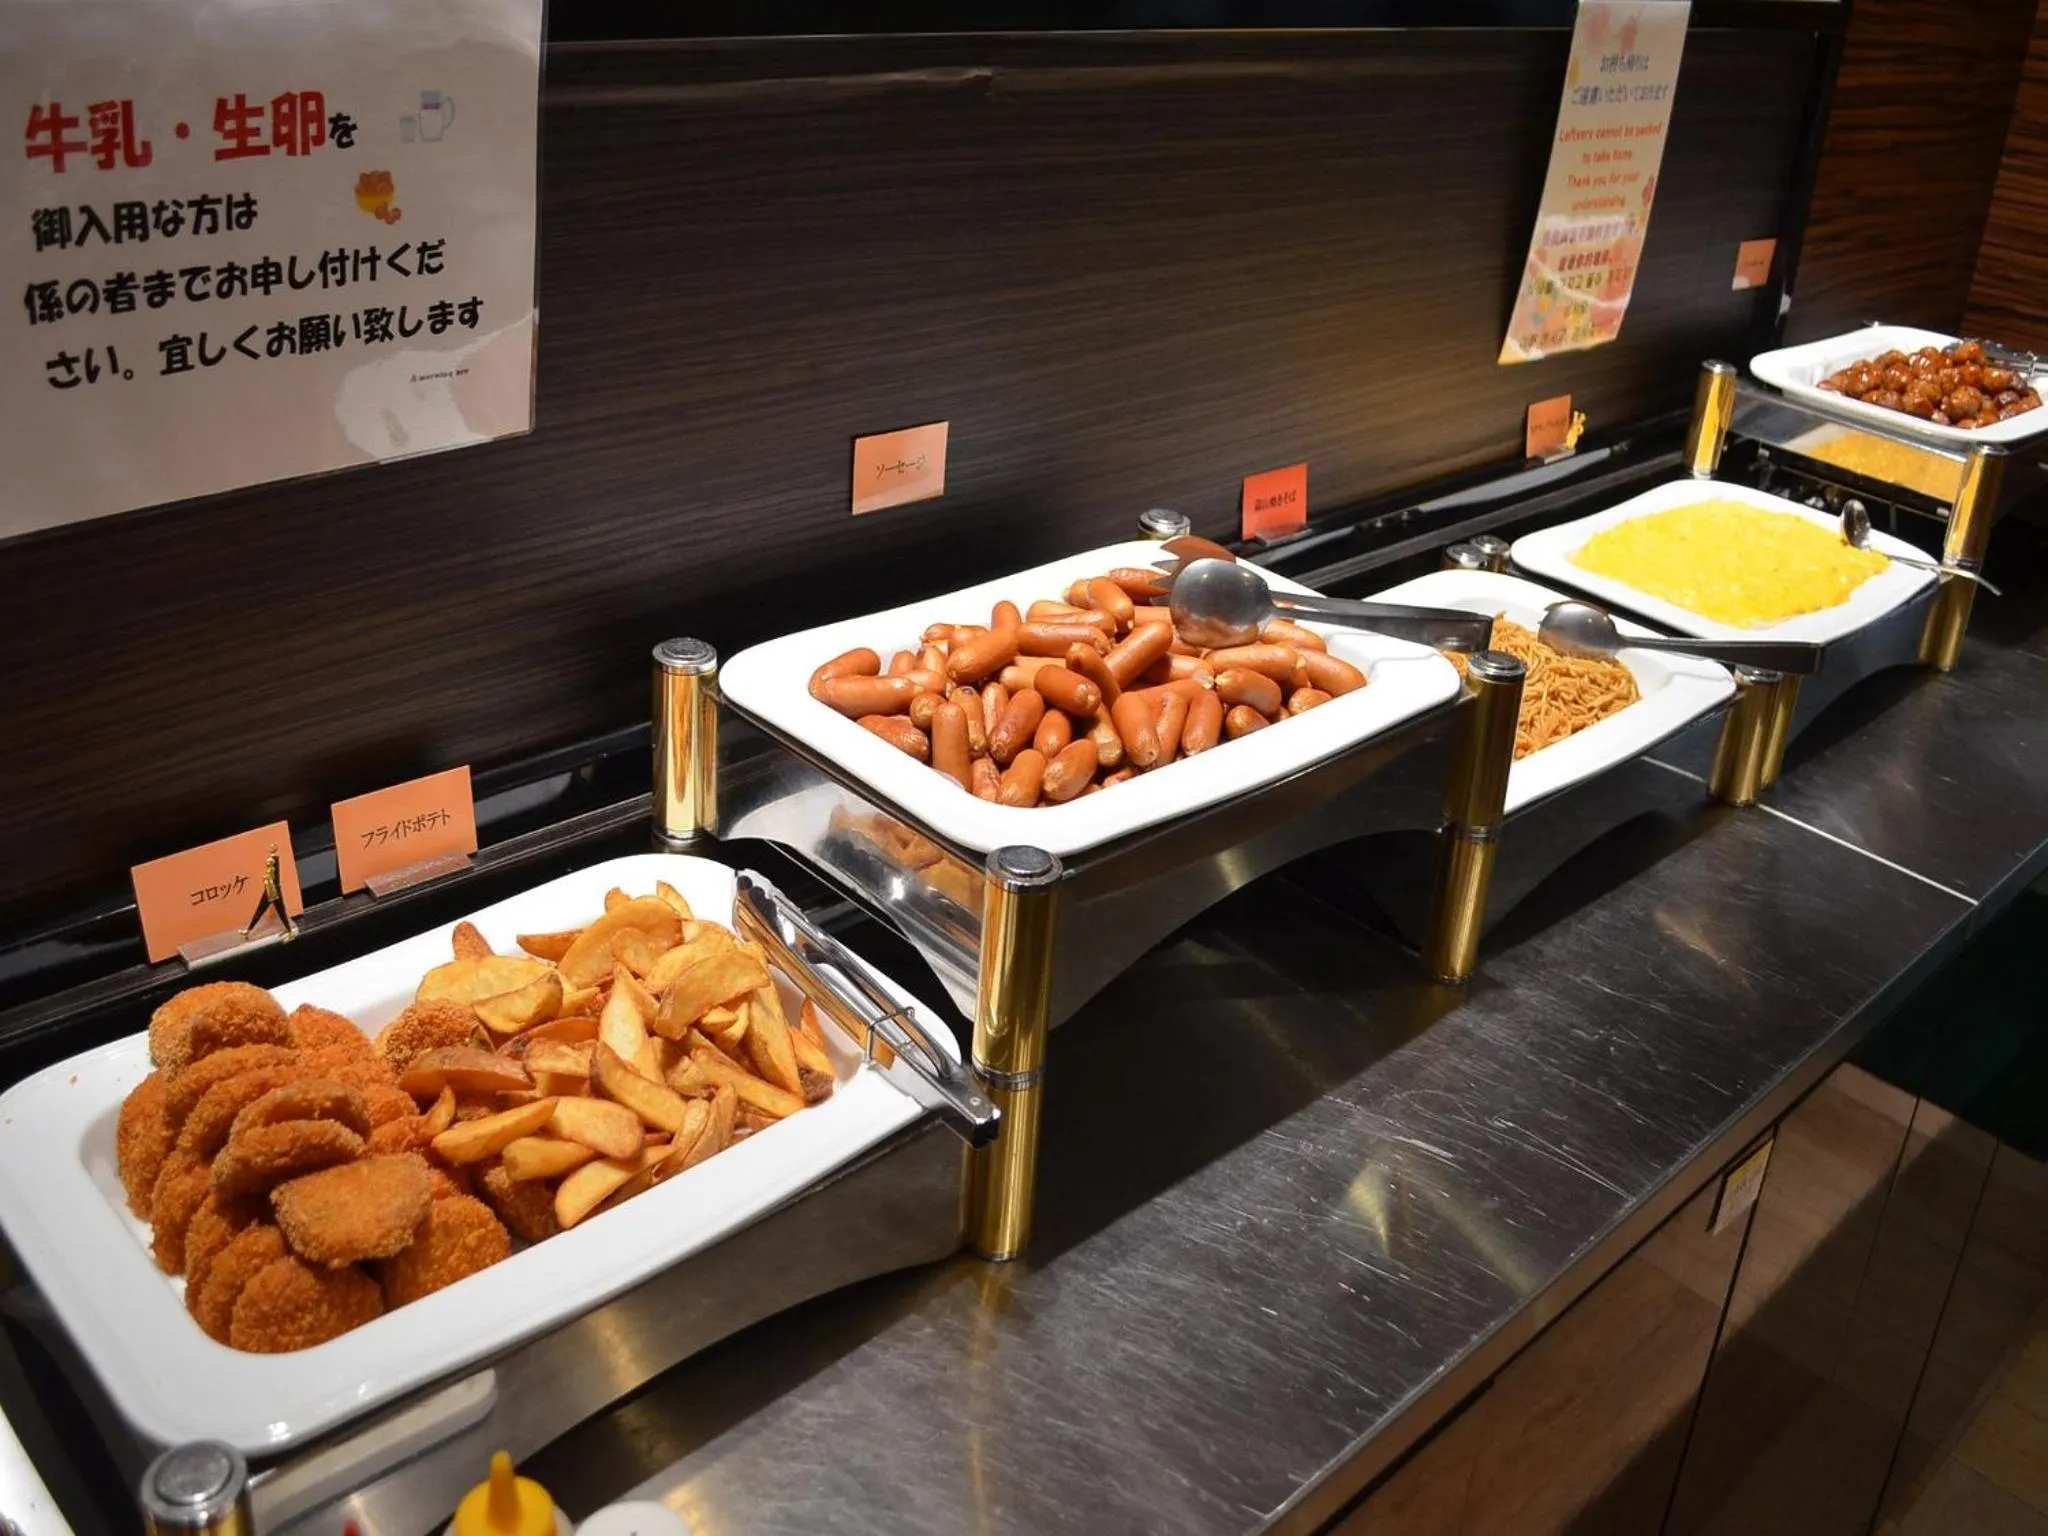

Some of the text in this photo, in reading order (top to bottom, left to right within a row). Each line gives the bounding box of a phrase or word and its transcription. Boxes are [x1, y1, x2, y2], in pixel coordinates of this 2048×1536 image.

[24, 90, 358, 173] 牛乳・生卵を
[1592, 150, 1610, 163] take
[1567, 174, 1592, 188] Thank
[1592, 175, 1607, 188] you
[32, 192, 258, 252] 御入用な方は
[23, 238, 446, 325] 係の者までお申し付けくだ
[46, 296, 484, 389] さい。宜しくお願い致します
[875, 454, 926, 480] ソーセージ
[360, 808, 452, 850] フライドポテト
[189, 874, 250, 906] コロッケ
